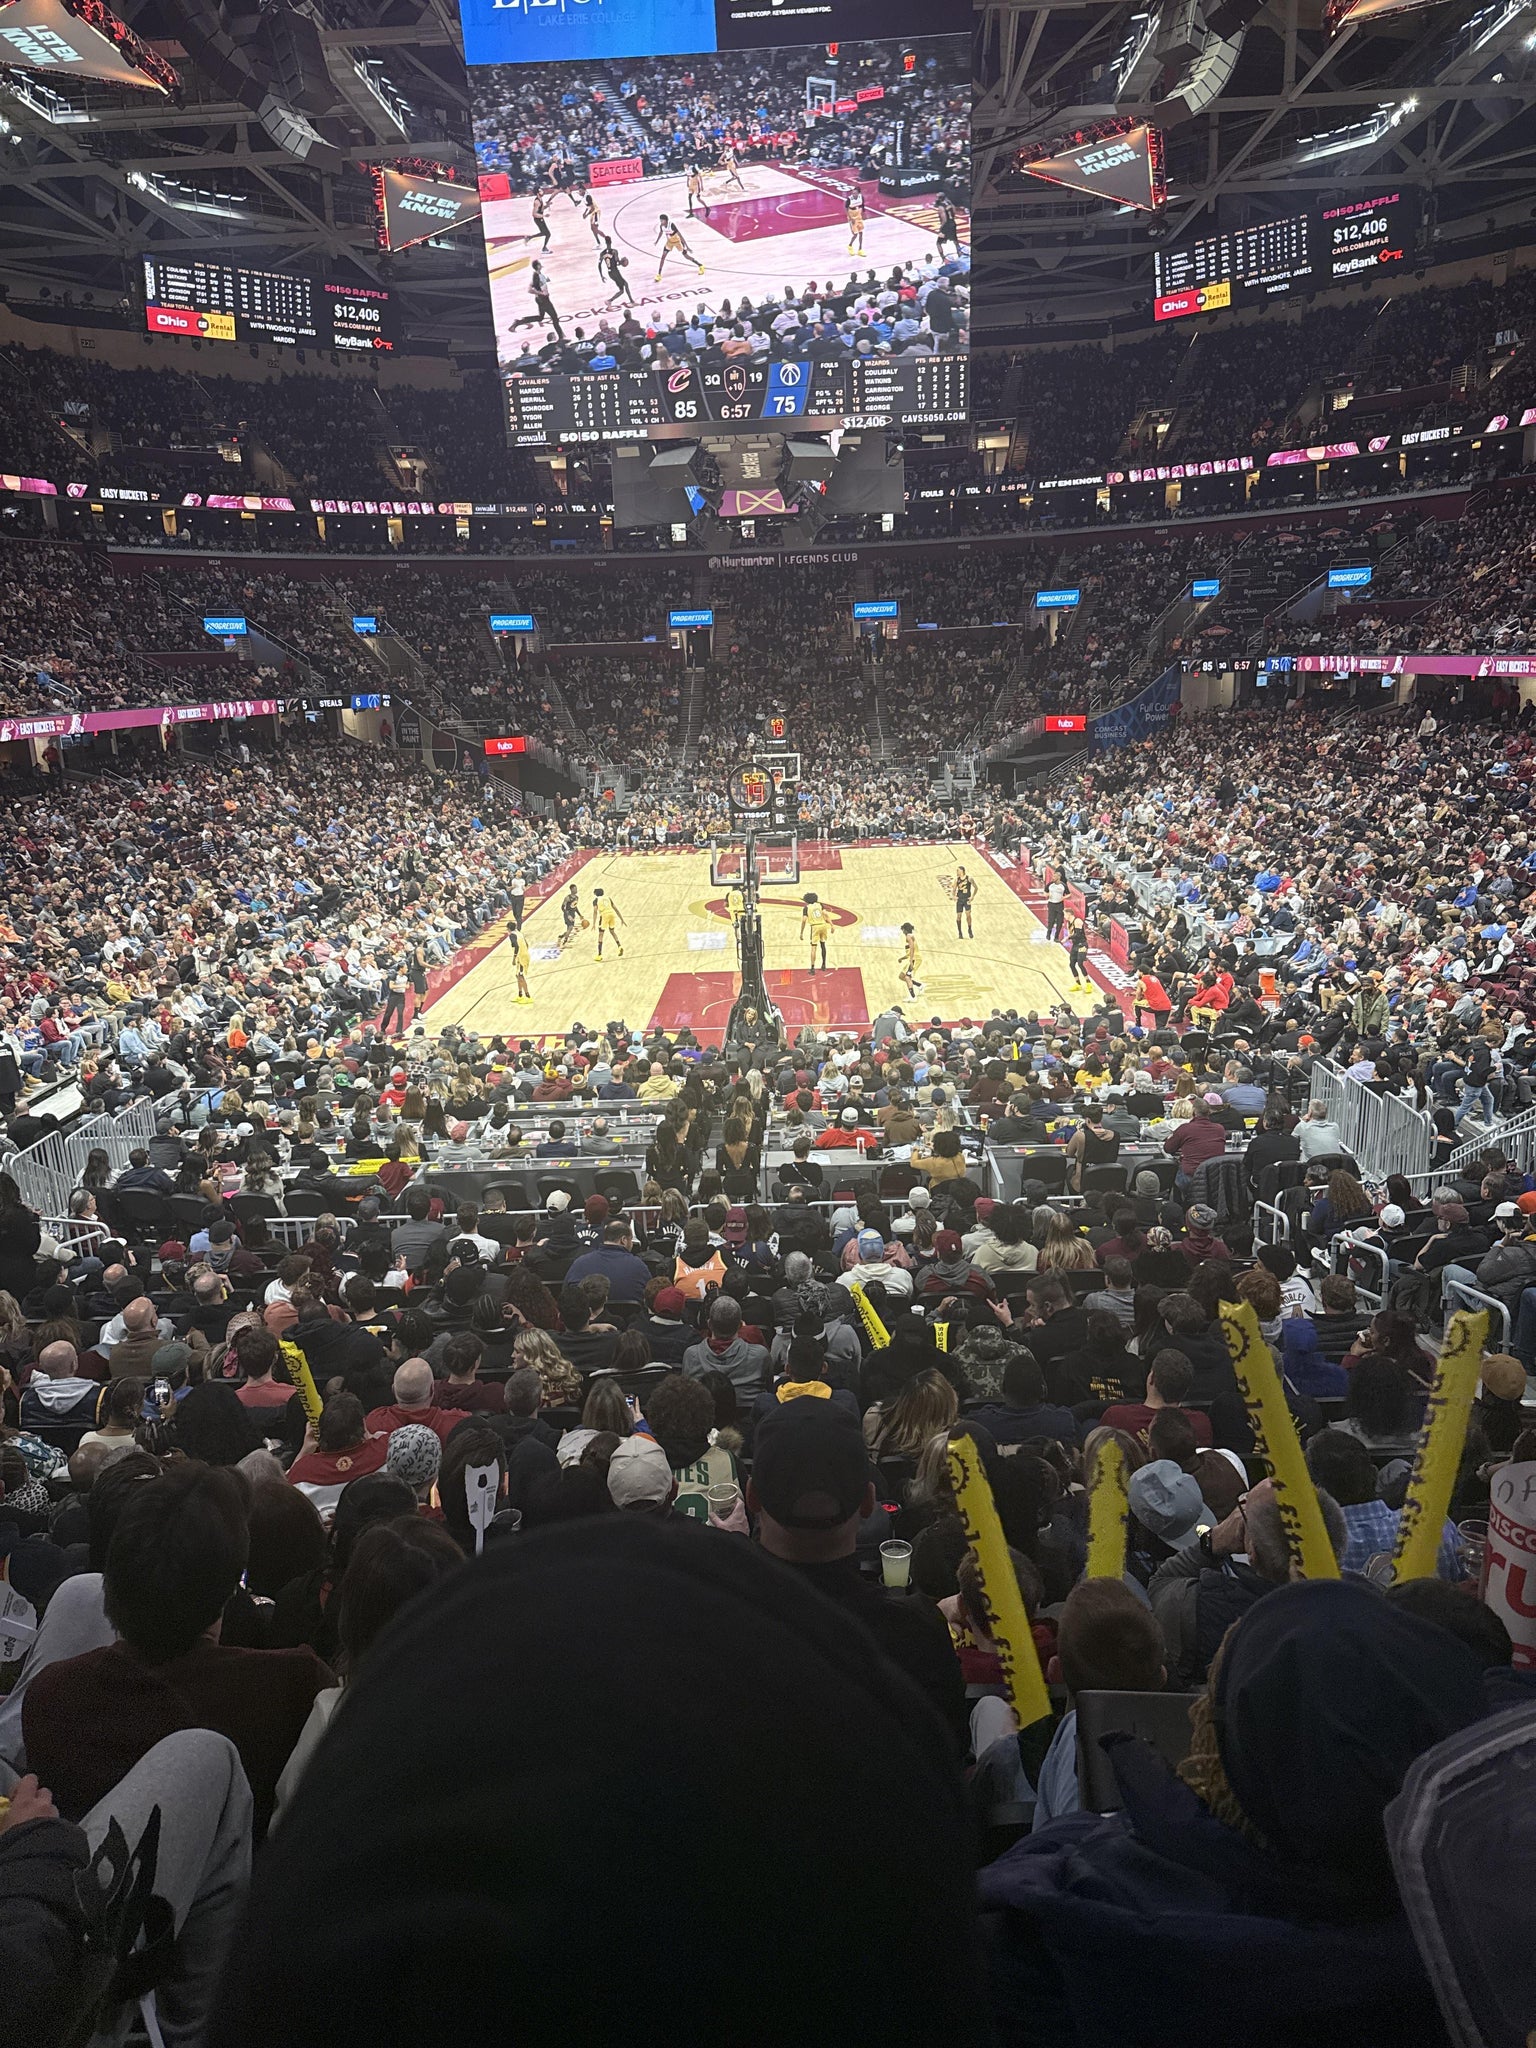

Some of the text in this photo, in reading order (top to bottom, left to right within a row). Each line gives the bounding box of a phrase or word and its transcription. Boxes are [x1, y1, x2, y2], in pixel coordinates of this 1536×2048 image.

[538, 11, 637, 26] LAKE ERIE COLLEGE
[1074, 142, 1132, 167] LET EM
[1080, 150, 1142, 176] KNOW.
[592, 162, 641, 179] SEATGEEK
[799, 170, 856, 192] CLIFFS
[404, 190, 462, 210] LET EM
[1354, 193, 1400, 212] RAFFLE
[398, 199, 457, 220] KNOW.
[1333, 217, 1388, 244] $12,406
[1331, 236, 1389, 255] CAVS.COM/RAFFLE
[1332, 255, 1379, 274] KeyBank
[1243, 278, 1259, 288] WITH
[1293, 266, 1313, 277] JAMES
[352, 286, 389, 300] RAFFLE
[1266, 283, 1290, 294] HARDEN
[641, 286, 713, 308] Arena
[1162, 291, 1228, 313] Ohio Rental
[334, 303, 380, 322] $12,406
[156, 314, 233, 332] Ohio Rental
[250, 321, 265, 330] WITH
[298, 327, 317, 336] JAMES
[333, 320, 382, 333] CAVS.COM/RAFFLE
[272, 335, 296, 344] HARDEN
[334, 334, 373, 348] KeyBank
[820, 361, 839, 369] FOULS
[864, 359, 890, 367] WIZARDS
[915, 357, 926, 365] PTS
[943, 355, 954, 363] AST
[630, 372, 648, 380] FOULS
[864, 368, 898, 376] COULIBALY
[518, 378, 550, 386] CAVALIERS
[598, 374, 608, 382] AST
[705, 374, 721, 386] 3Q
[729, 382, 743, 391] +10
[750, 372, 763, 383] 19
[864, 377, 892, 385] WATKINS
[519, 387, 545, 395] HARDEN
[864, 386, 904, 394] CARRINGTON
[520, 396, 546, 404] MERRILL
[773, 395, 796, 414] 75
[864, 395, 894, 403] JOHNSON
[674, 401, 697, 419] 85
[720, 404, 752, 419] 6:57
[865, 404, 891, 412] GEORGE
[522, 413, 542, 421] TYSON
[843, 411, 966, 429] $12,406 CAVS5050.COM
[523, 422, 543, 430] ALLEN
[517, 431, 547, 443] oswald
[602, 429, 648, 440] RAFFLE
[1401, 427, 1450, 445] EASY BUCKETS
[920, 489, 944, 498] FOULS
[965, 487, 980, 495] TOL
[1016, 483, 1027, 491] PM
[1039, 480, 1057, 489] LET
[1058, 480, 1072, 488] EM
[1072, 476, 1103, 487] KNOW.
[100, 488, 148, 501] EASY BUCKETS
[475, 504, 497, 512] oswald
[571, 504, 586, 512] TOL
[784, 554, 829, 565] LEGENDS
[832, 552, 858, 563] CLUB
[1330, 573, 1368, 583] PROGRESSIVE
[1038, 594, 1077, 602] PROGRESSIVE
[856, 605, 894, 613] PROGRESSIVE
[1221, 607, 1258, 616] Construction
[492, 619, 530, 627] PROGRESSIVE
[671, 614, 710, 622] PROGRESSIVE
[206, 622, 243, 630] PROGRESSIVE
[1203, 660, 1279, 671] 85 6:57 19 75
[1496, 661, 1529, 672] EASY BUCKETS
[320, 699, 343, 707] STEALS
[1140, 703, 1153, 713] Full
[1058, 719, 1073, 728] fubo
[1145, 713, 1169, 722] Power
[19, 723, 33, 734] EASY
[34, 721, 56, 733] BUCKETS
[772, 725, 784, 737] 19
[1094, 725, 1127, 733] COMCAST
[497, 741, 512, 750] fubo
[742, 773, 767, 784] 6:57
[744, 811, 771, 819] TISSOT
[683, 1260, 715, 1276] HARDEN
[695, 1278, 706, 1300] 1
[1282, 1293, 1306, 1306] OBLEY
